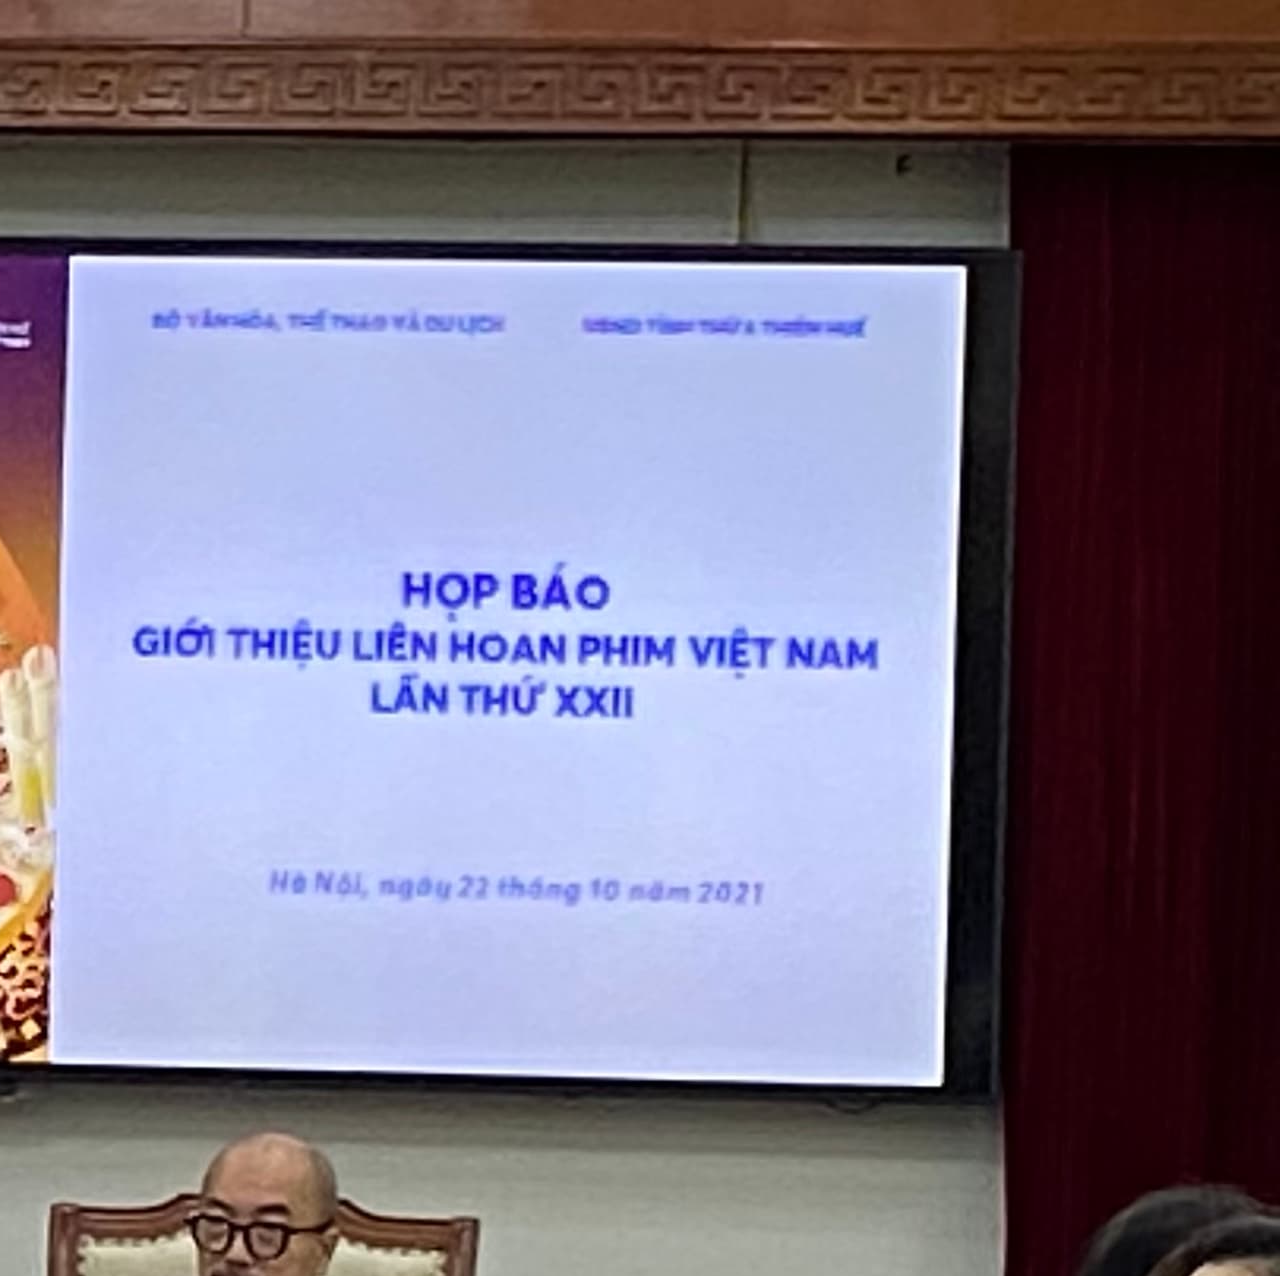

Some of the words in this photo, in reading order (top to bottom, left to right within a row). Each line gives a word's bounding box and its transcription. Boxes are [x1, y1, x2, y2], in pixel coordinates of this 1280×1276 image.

[402, 571, 499, 622] HỌP
[510, 561, 611, 611] BÁO
[132, 615, 216, 658] GIỚI
[226, 617, 341, 671] THIỆU
[352, 620, 438, 663] LIÊN
[449, 630, 567, 665] HOAN
[577, 633, 676, 668] PHIM
[687, 625, 776, 680] VIỆT
[785, 635, 880, 671] NAM
[458, 674, 547, 717] THỨ
[554, 684, 635, 719] XXII
[696, 880, 766, 906] 2021
